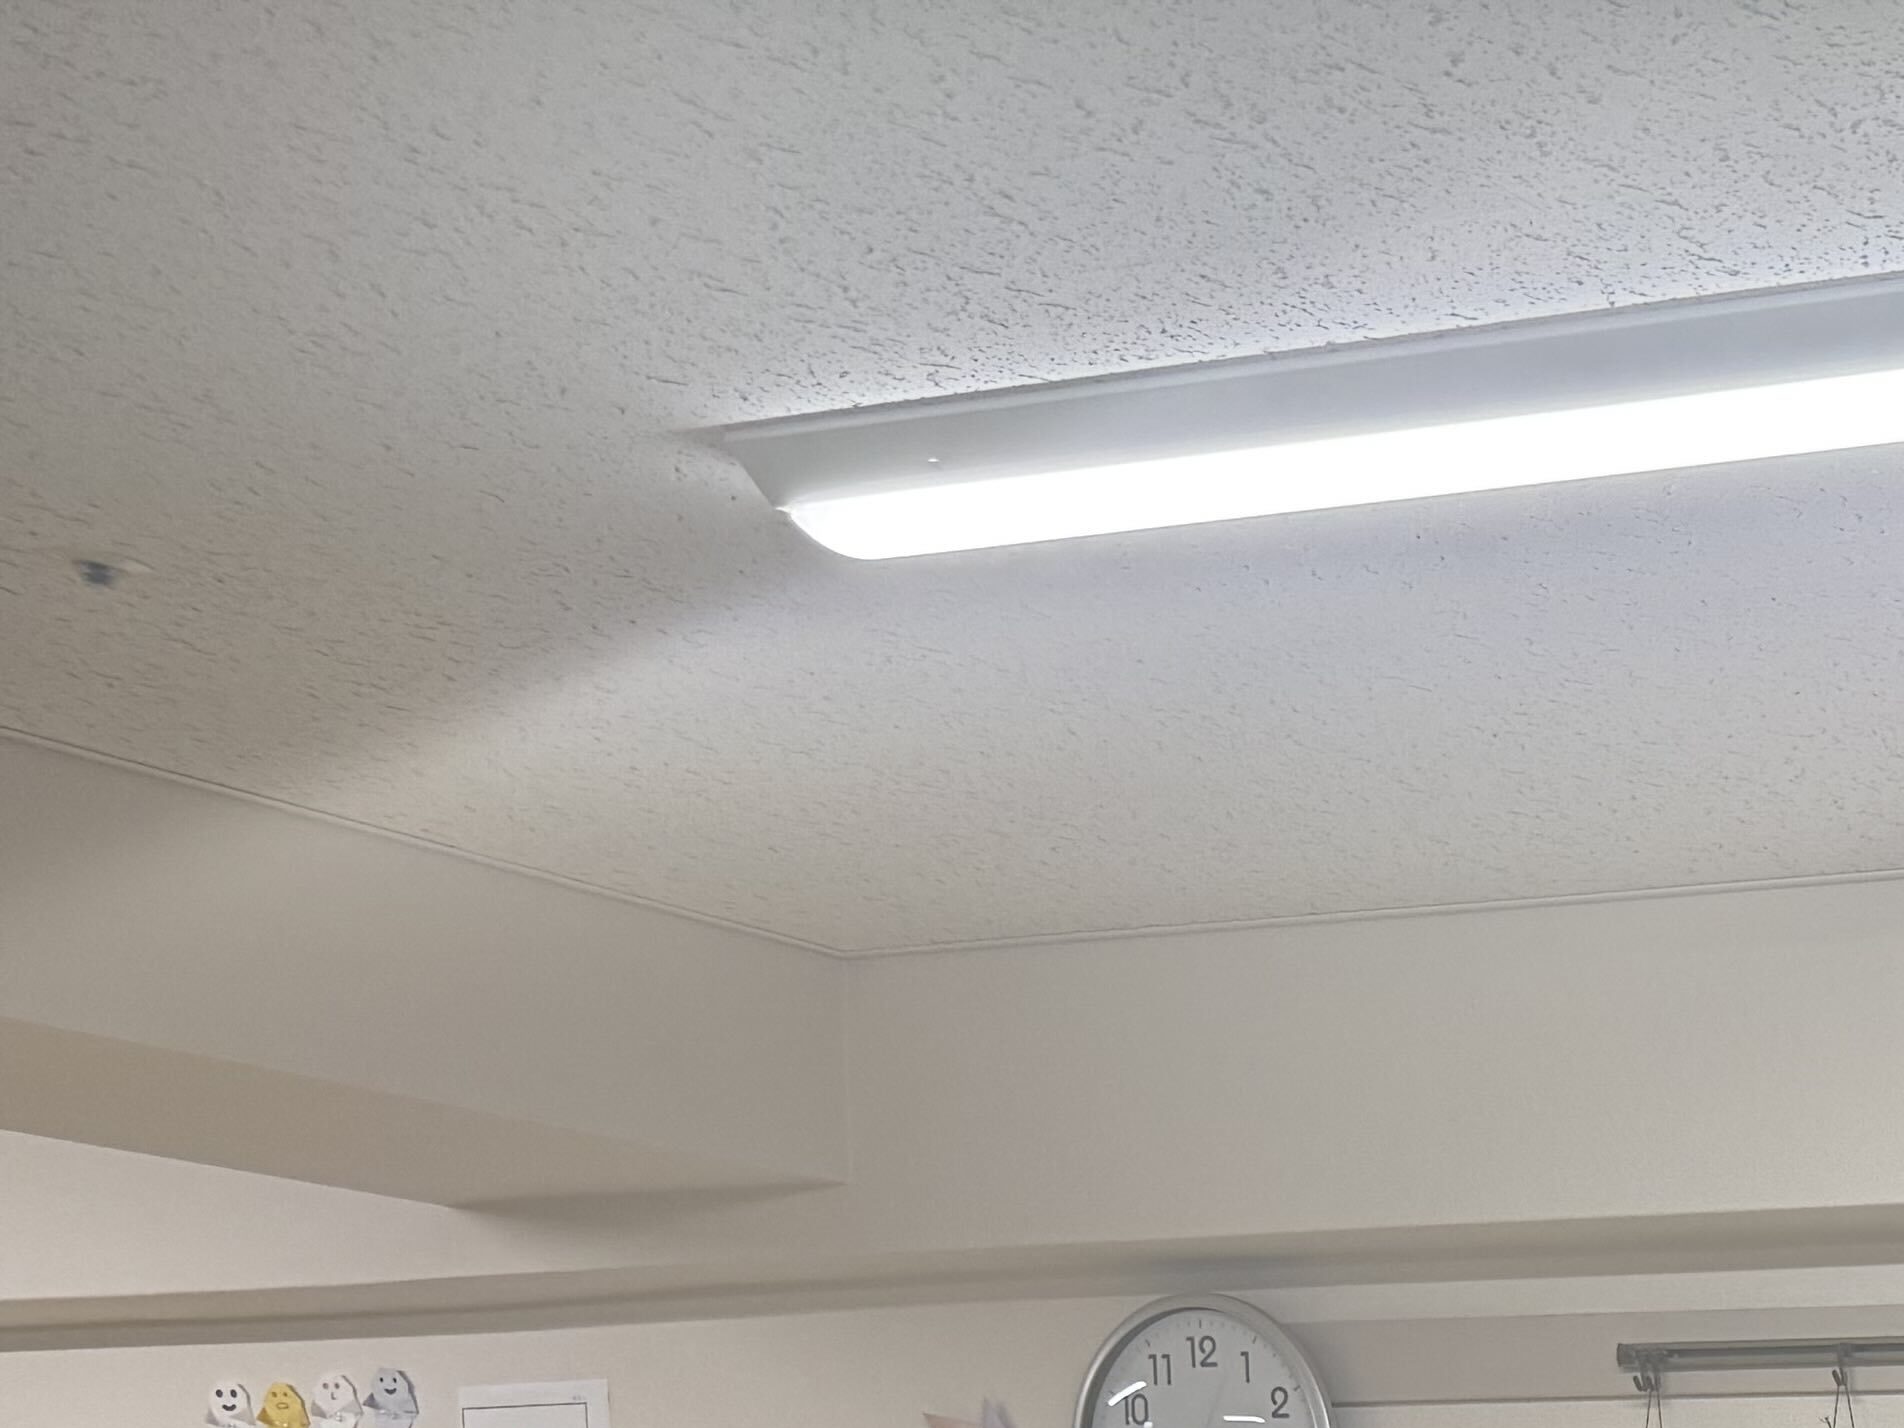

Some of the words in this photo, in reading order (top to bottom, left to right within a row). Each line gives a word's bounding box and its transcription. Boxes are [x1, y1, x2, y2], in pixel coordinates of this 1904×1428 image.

[1186, 1335, 1218, 1368] 12
[1240, 1351, 1251, 1383] 1
[1148, 1353, 1172, 1386] 11
[1122, 1393, 1149, 1426] 10
[1270, 1386, 1290, 1419] 2
